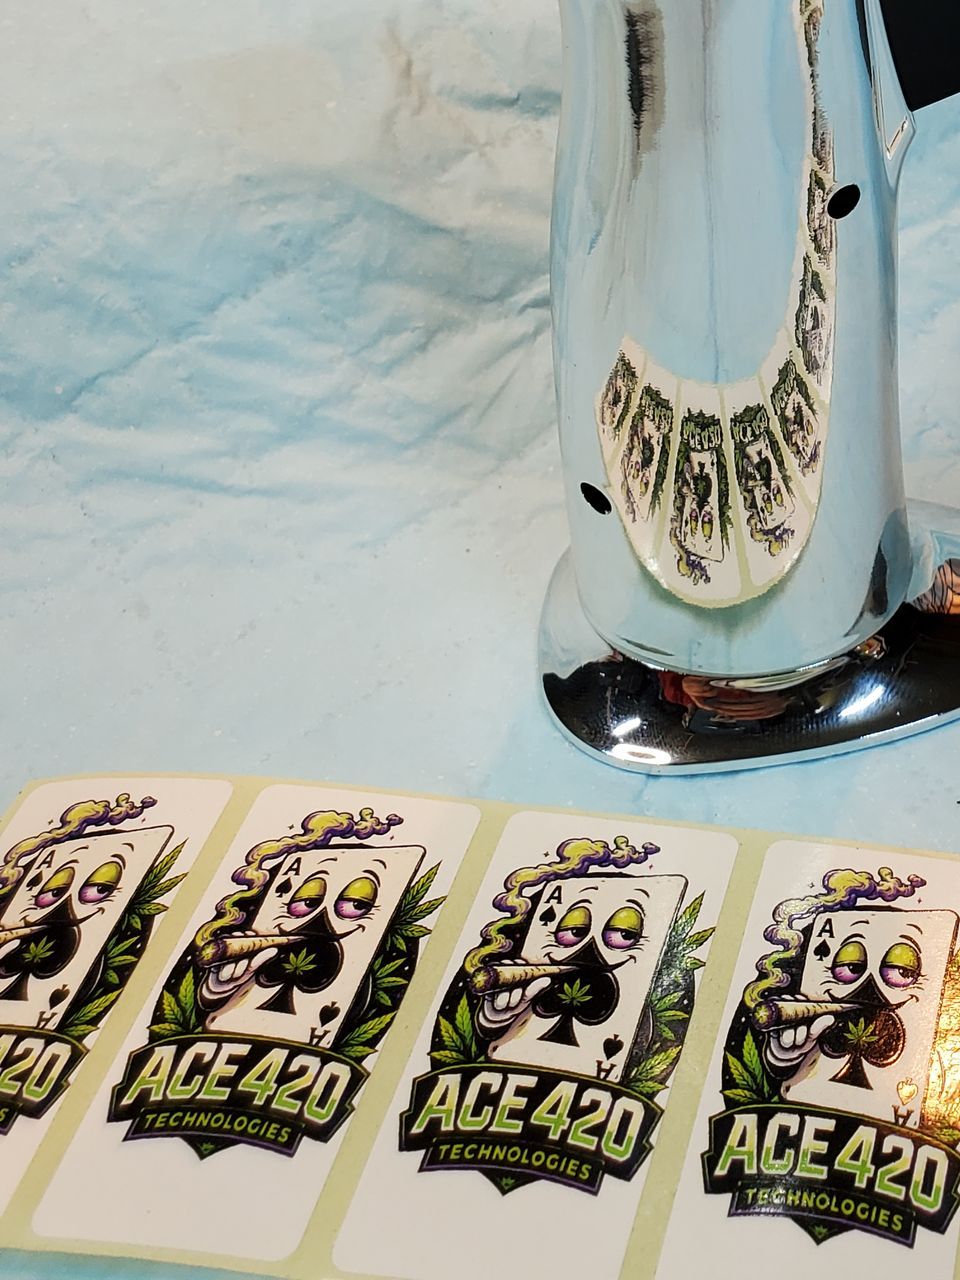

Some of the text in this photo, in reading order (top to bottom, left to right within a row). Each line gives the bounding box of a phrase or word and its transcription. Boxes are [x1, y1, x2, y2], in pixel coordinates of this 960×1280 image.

[145, 1112, 292, 1144] TECHNOLOGIES
[438, 1143, 592, 1180] TECHNOLOGIES
[745, 1187, 904, 1231] TECHNOLOGIES
